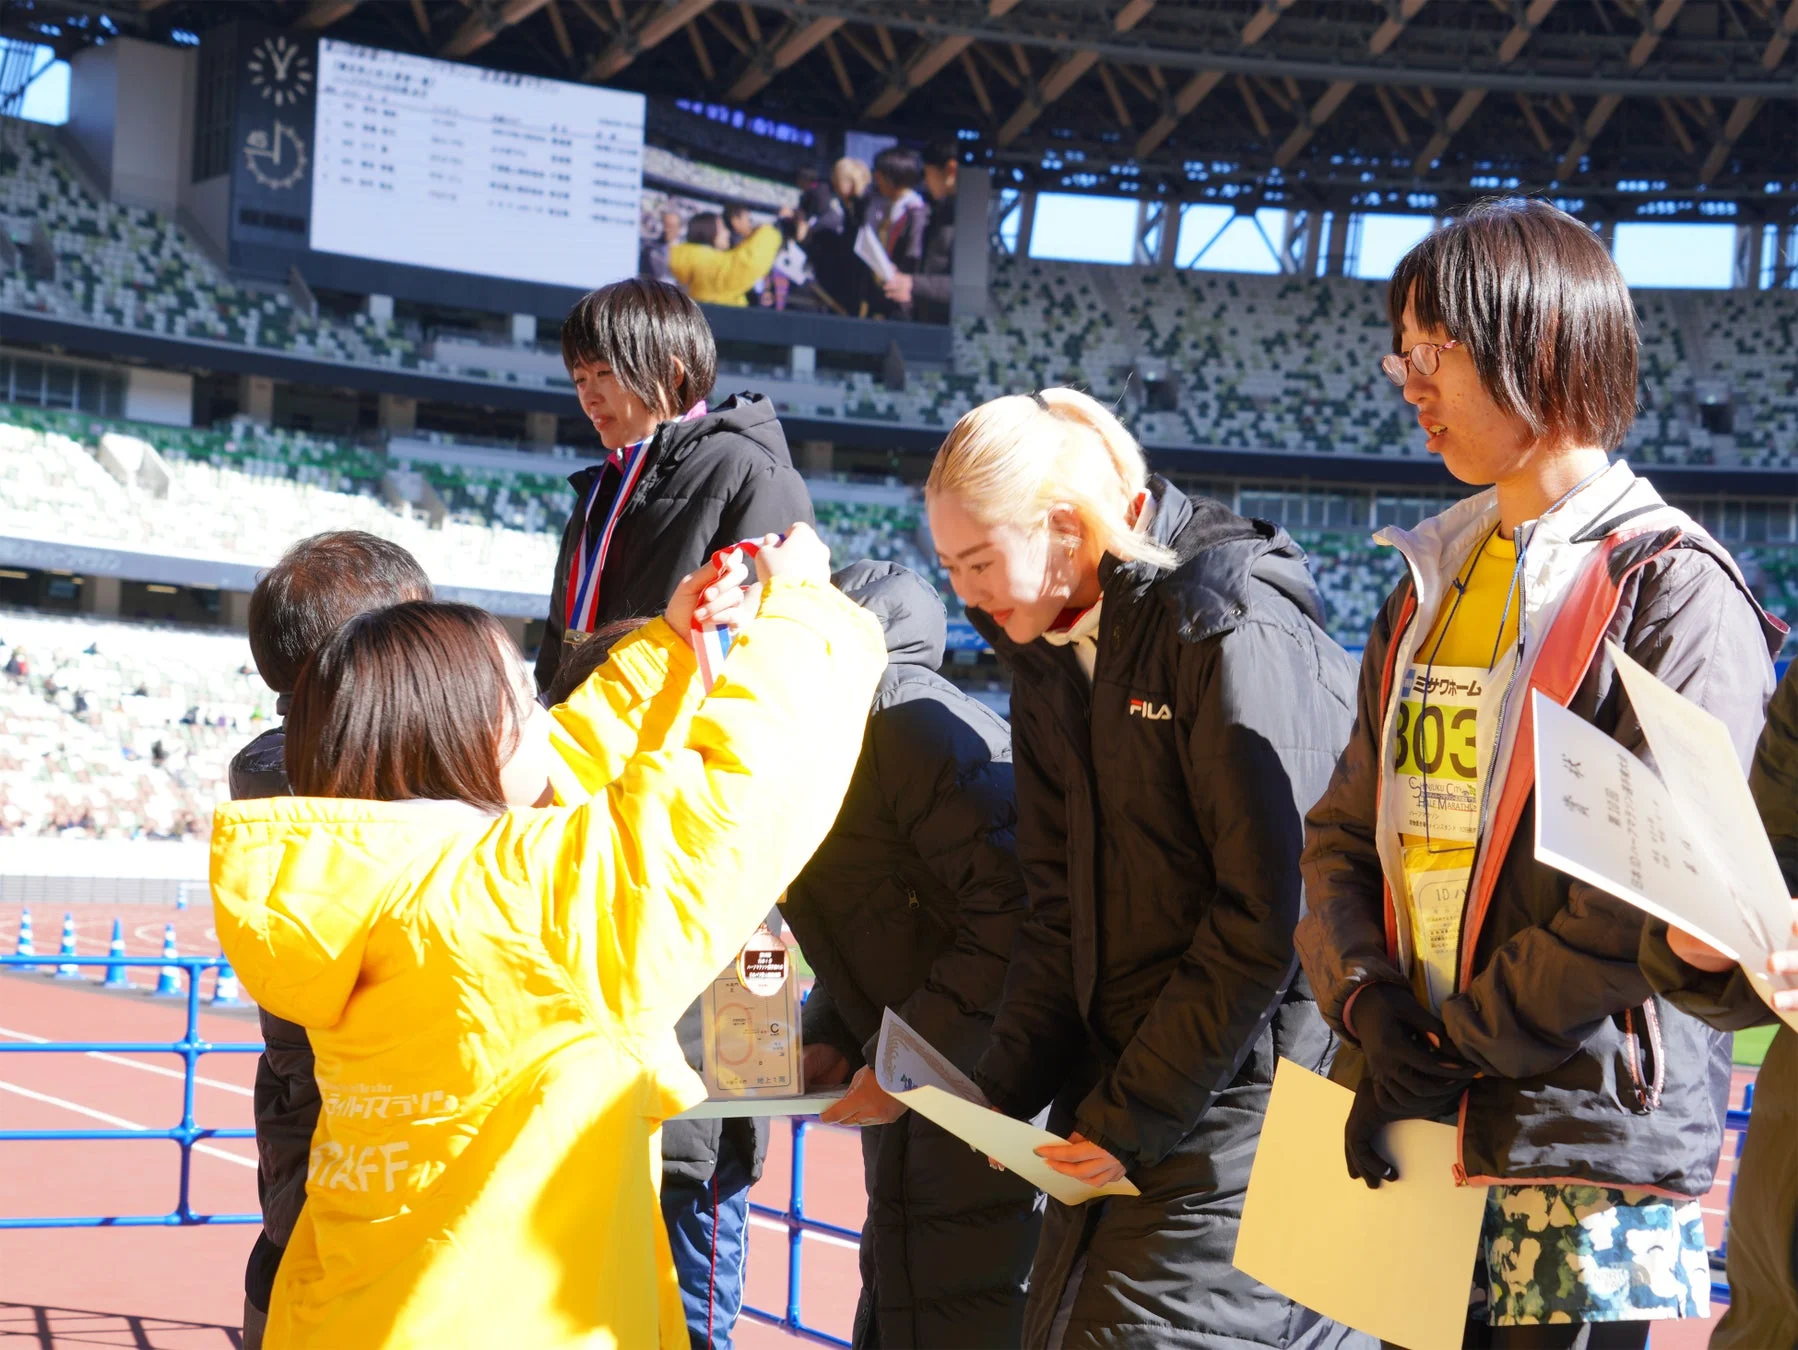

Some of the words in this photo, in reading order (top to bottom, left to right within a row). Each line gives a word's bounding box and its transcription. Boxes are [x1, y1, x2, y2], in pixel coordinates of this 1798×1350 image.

[1413, 675, 1482, 696] ミサワホーム
[1129, 698, 1172, 720] FILA
[1408, 776, 1444, 799] SHNJUKU
[1416, 796, 1437, 808] HLF
[770, 1023, 780, 1033] C
